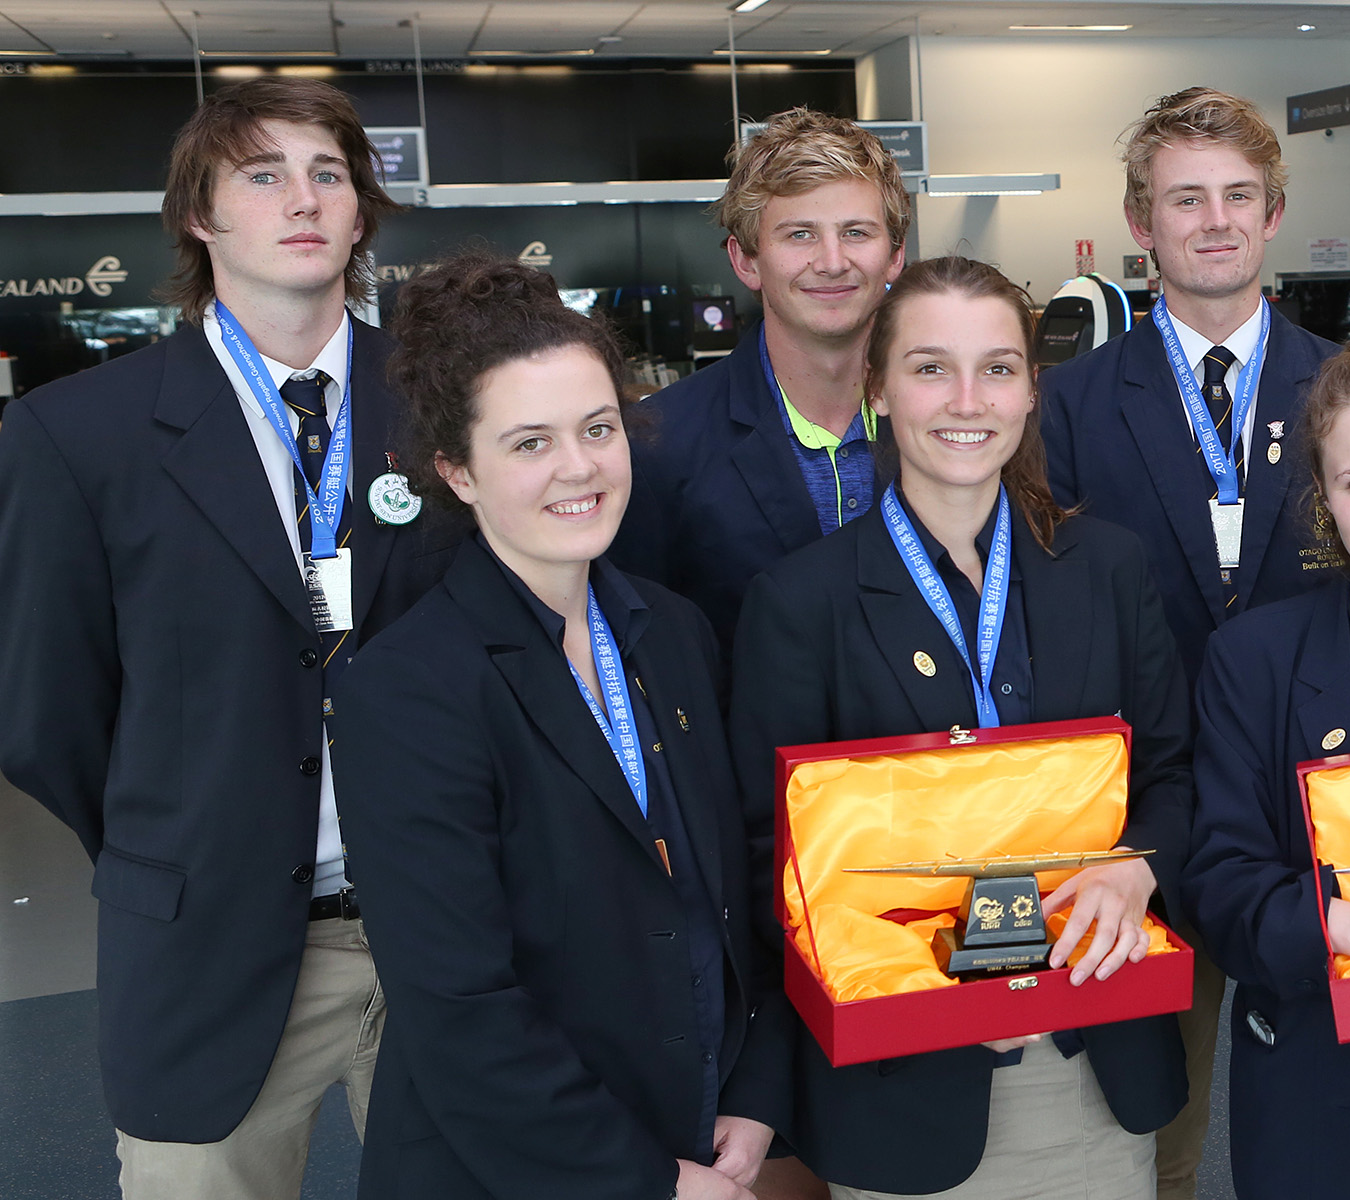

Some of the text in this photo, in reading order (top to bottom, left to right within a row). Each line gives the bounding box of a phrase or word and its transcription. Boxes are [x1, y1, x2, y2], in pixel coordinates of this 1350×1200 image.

[920, 179, 928, 193] 1
[417, 189, 428, 204] 3
[0, 278, 84, 297] ALAND
[219, 318, 234, 335] China
[269, 403, 286, 429] Rowing
[1302, 562, 1320, 571] Built
